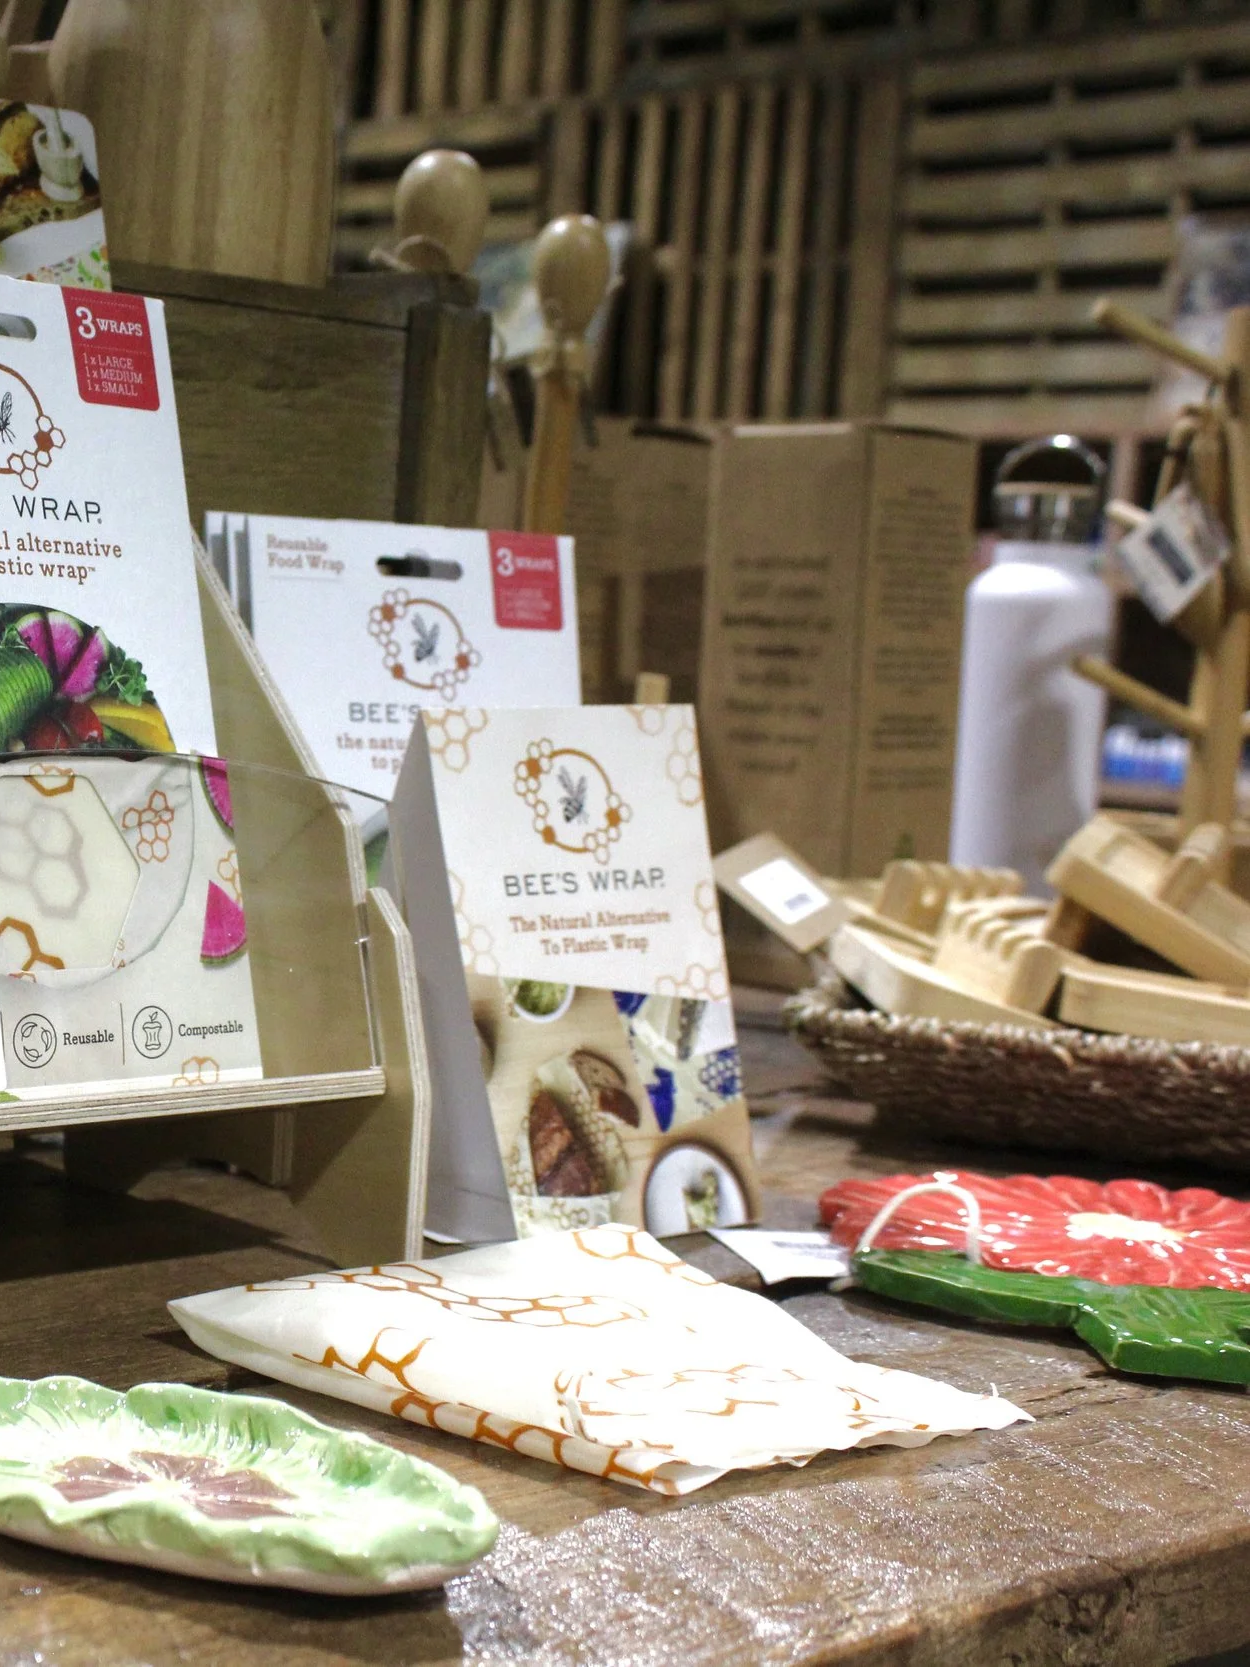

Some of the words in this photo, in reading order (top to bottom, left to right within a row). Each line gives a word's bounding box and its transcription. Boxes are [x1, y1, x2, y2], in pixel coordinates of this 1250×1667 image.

[75, 306, 96, 339] 3
[96, 318, 144, 337] WRAPS
[98, 354, 135, 370] LARGE
[100, 368, 143, 385] MEDIUM
[102, 381, 138, 397] SMALL
[17, 533, 123, 558] alternative
[496, 547, 515, 577] 3
[504, 872, 579, 897] BEE'S
[509, 915, 537, 933] The
[539, 912, 592, 931] Natural
[597, 910, 671, 928] Alternative
[540, 937, 560, 955] To
[562, 936, 607, 954] Plastic
[610, 933, 649, 953] Wrap
[63, 1030, 115, 1046] Reusable
[178, 1021, 244, 1039] Compostable
